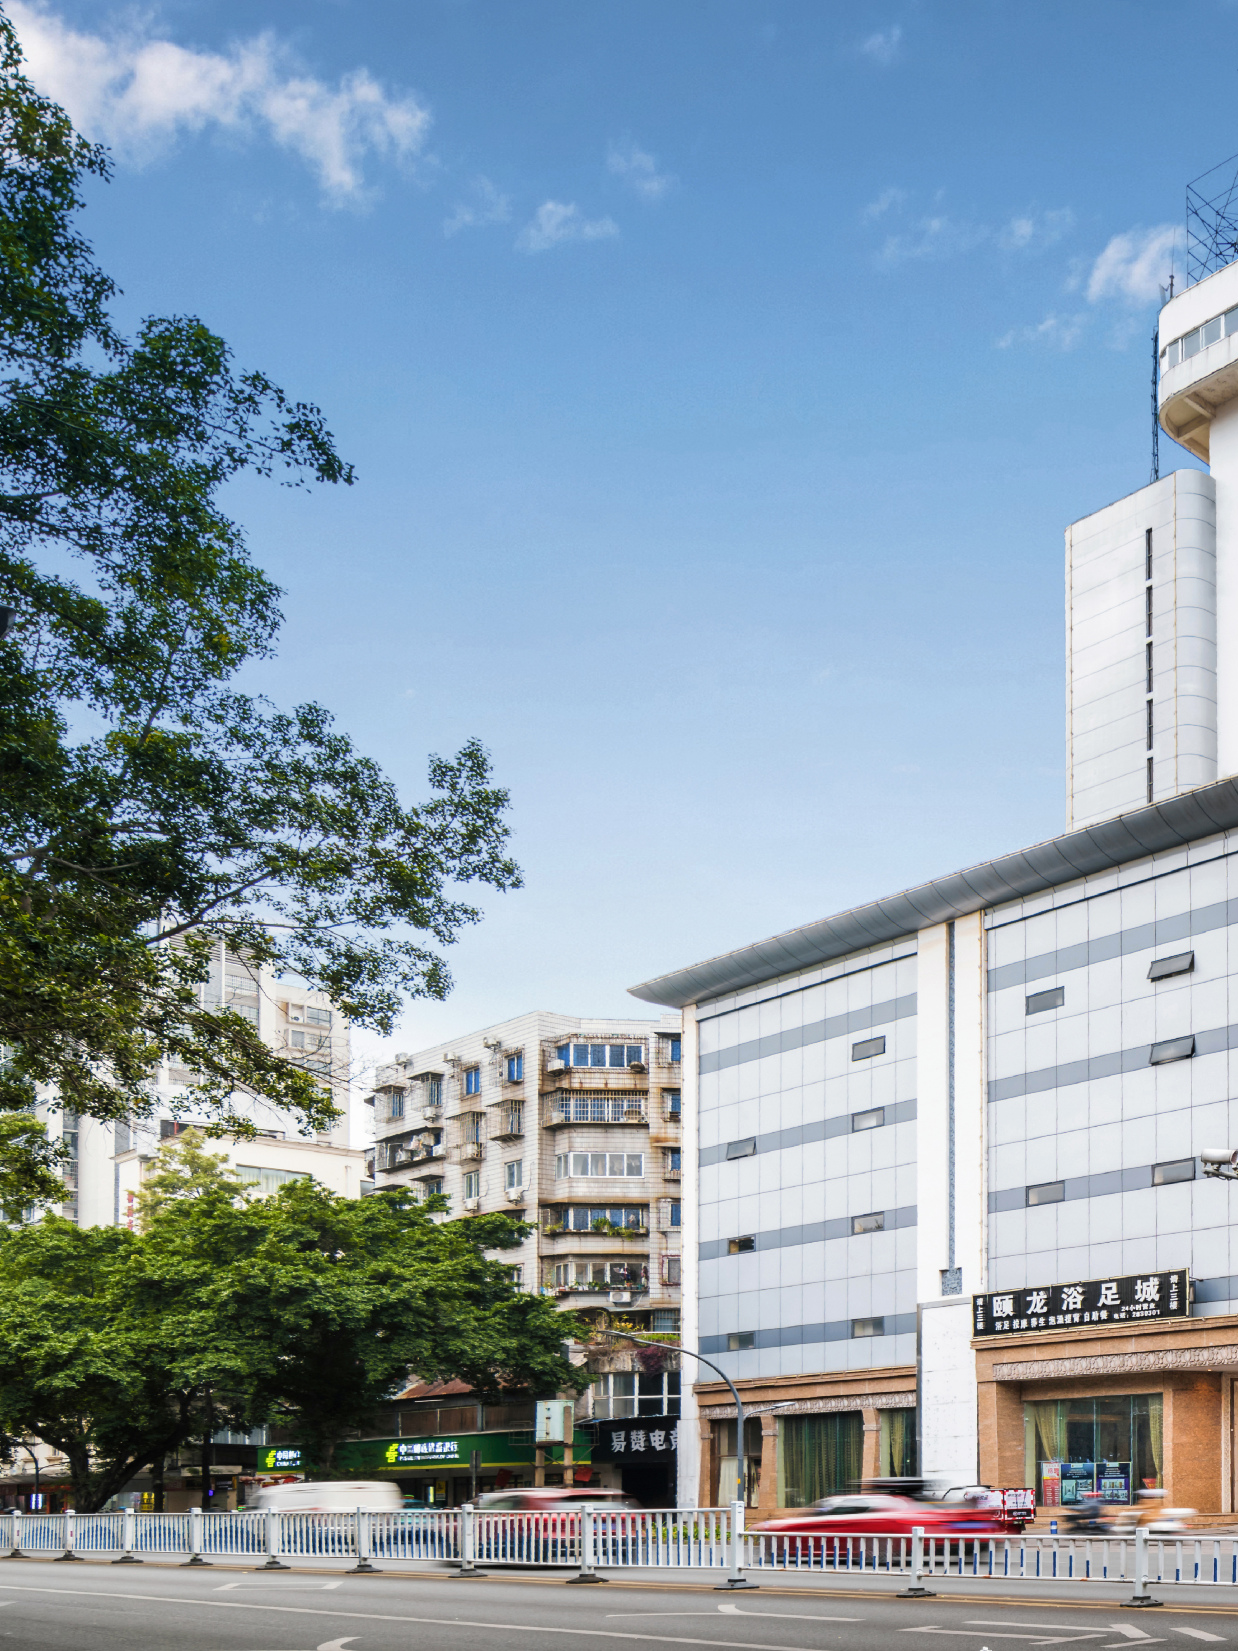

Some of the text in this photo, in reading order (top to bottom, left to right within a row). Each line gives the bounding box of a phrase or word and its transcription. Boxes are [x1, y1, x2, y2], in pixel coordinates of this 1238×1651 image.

[992, 1276, 1161, 1318] 颐龙浴足城
